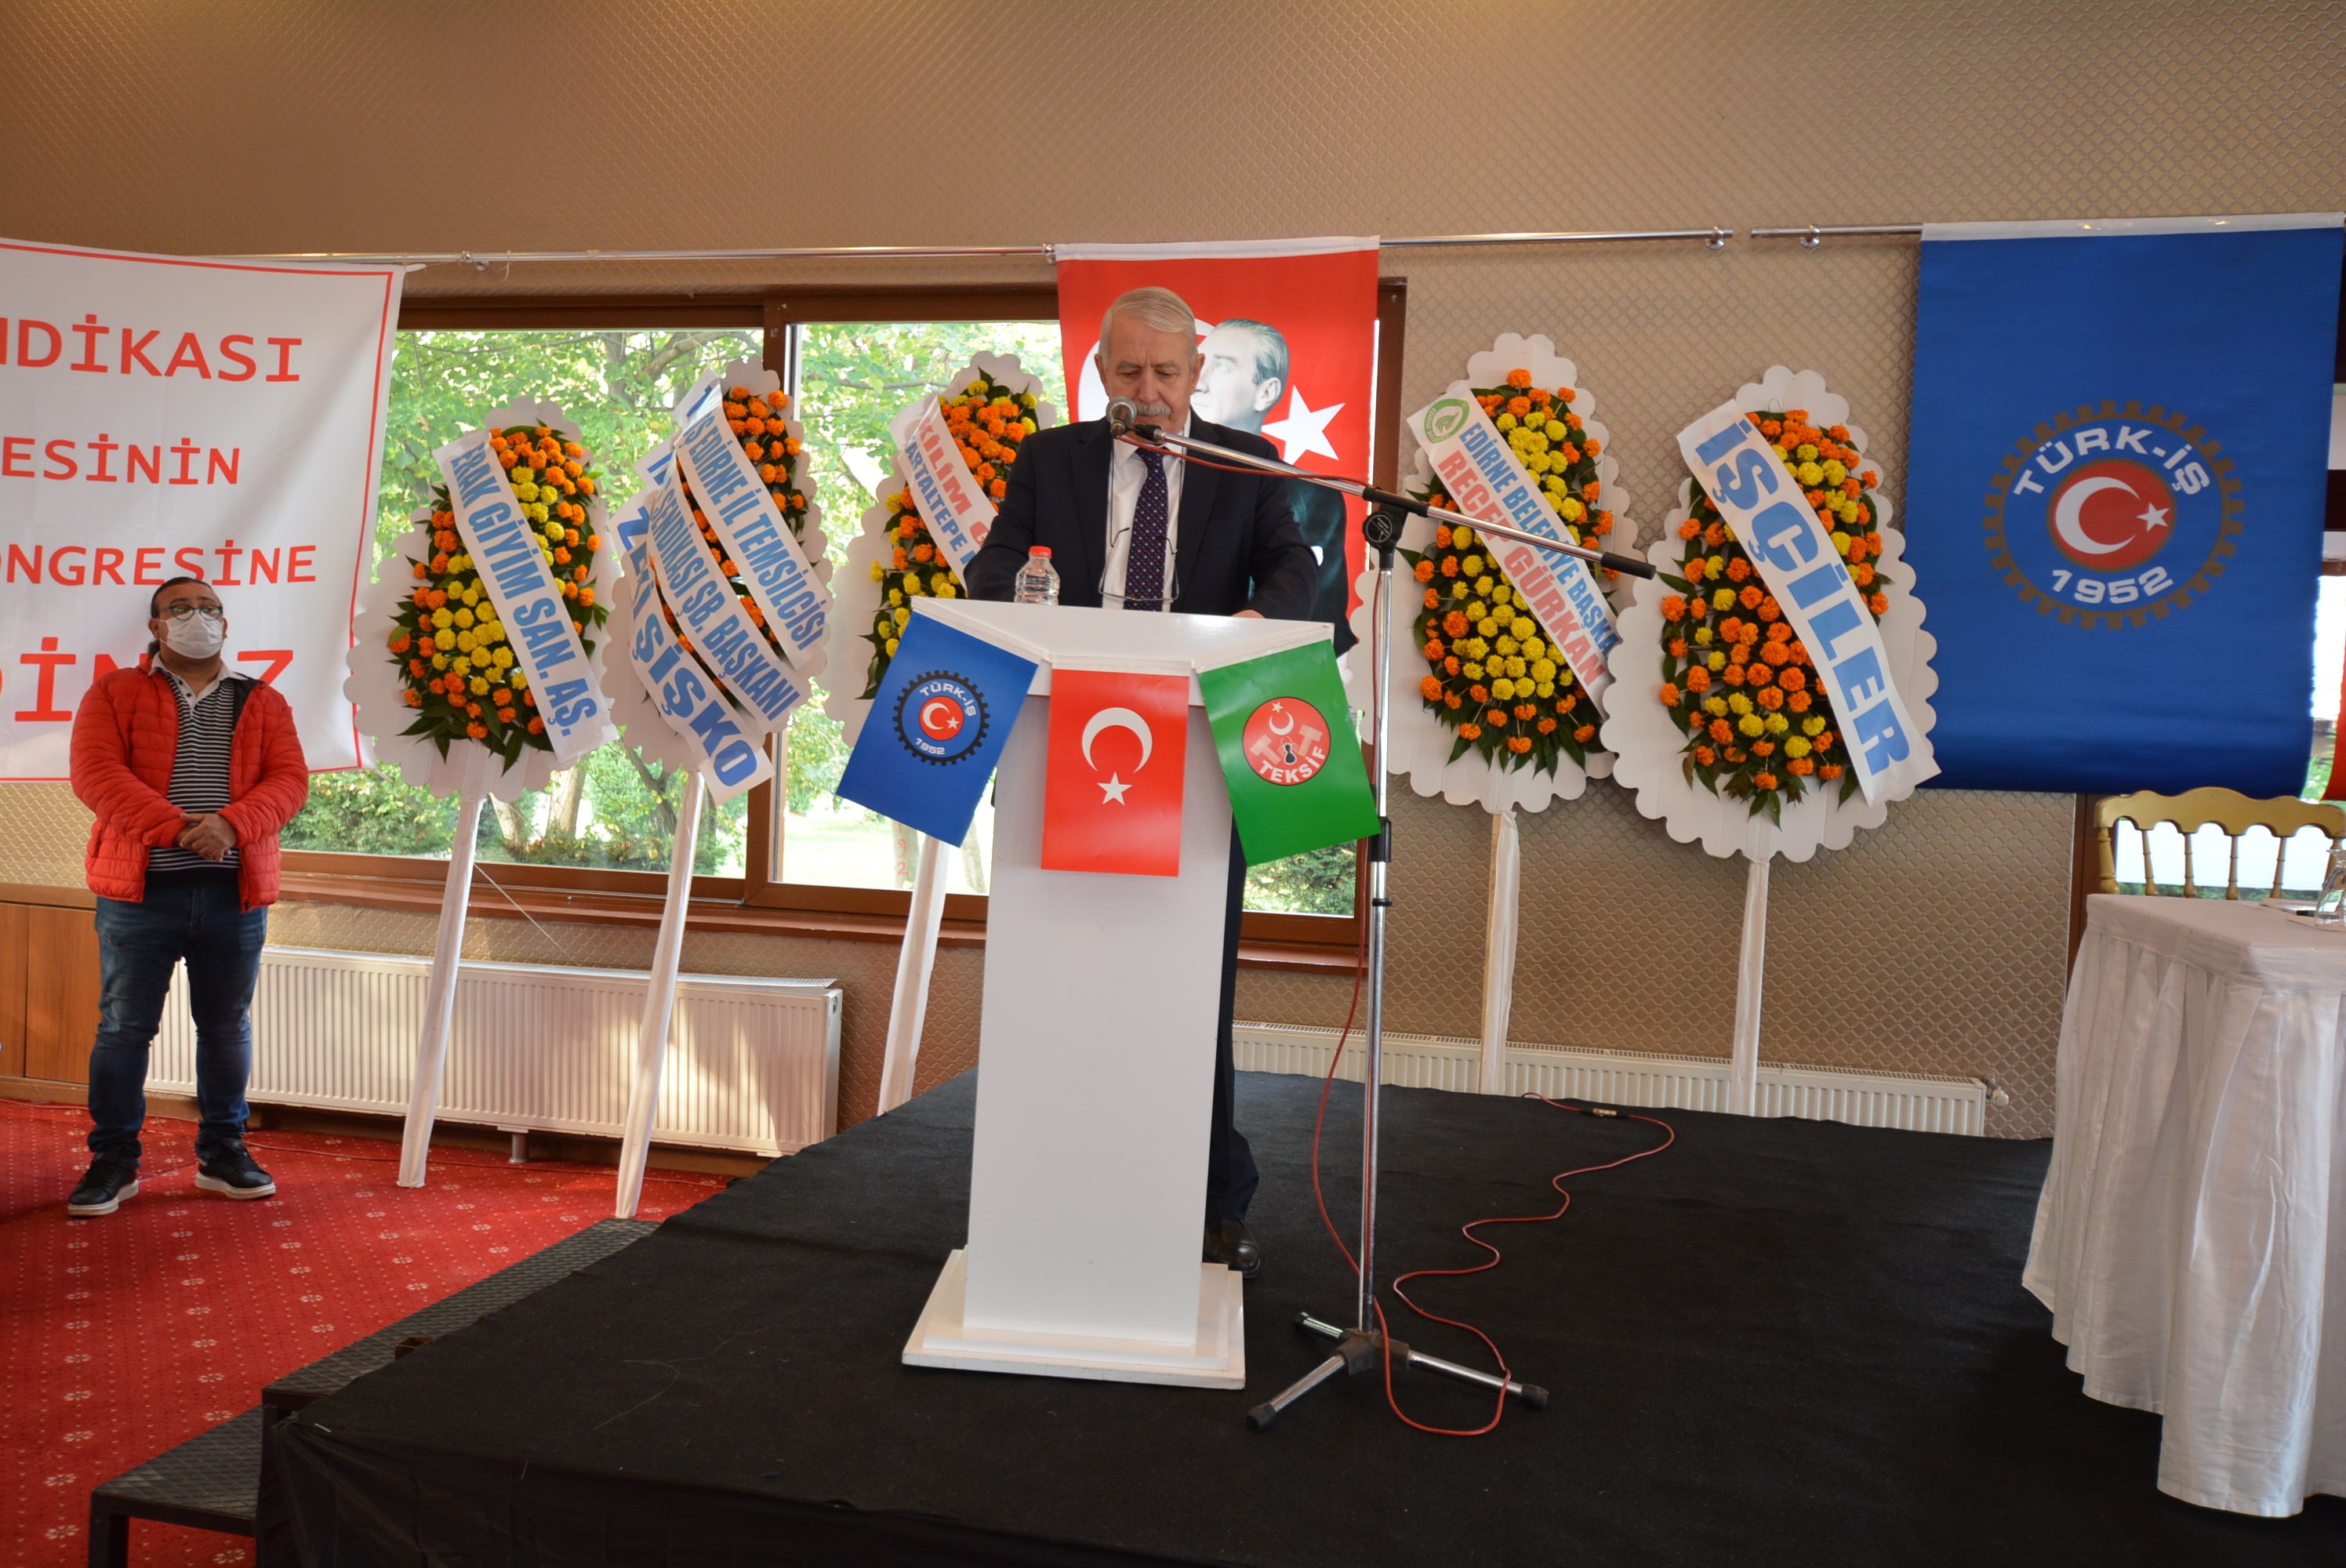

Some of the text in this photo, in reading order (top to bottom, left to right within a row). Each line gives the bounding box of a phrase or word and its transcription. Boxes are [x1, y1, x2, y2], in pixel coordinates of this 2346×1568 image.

[0, 314, 302, 383] DİKASI
[2, 434, 240, 485] ESİNİN
[688, 426, 749, 506] EDİRNE
[905, 436, 968, 552] ARTALTEPE
[918, 416, 972, 515] KİLİM
[2013, 426, 2210, 495] TÜRK-İŞ
[651, 488, 709, 598] SENDİKASI
[718, 488, 762, 526] İL
[1459, 422, 1518, 493] EDİRNE
[1567, 577, 1619, 660] BAŞKA
[0, 539, 316, 586] NGRESİNE
[451, 441, 597, 737] ERAK GİYİM SAN. AŞ.
[1694, 419, 1909, 776] İŞÇİLER
[2052, 566, 2174, 604] 1952
[677, 580, 725, 633] ŞB.
[1504, 546, 1605, 687] GÜRKAN
[632, 613, 757, 786] ŞİŞKO
[702, 614, 800, 721] BAŞKANI
[920, 681, 976, 717] TÜRK-İŞ
[915, 738, 946, 755] 1952
[1259, 746, 1325, 783] TEKSİF
